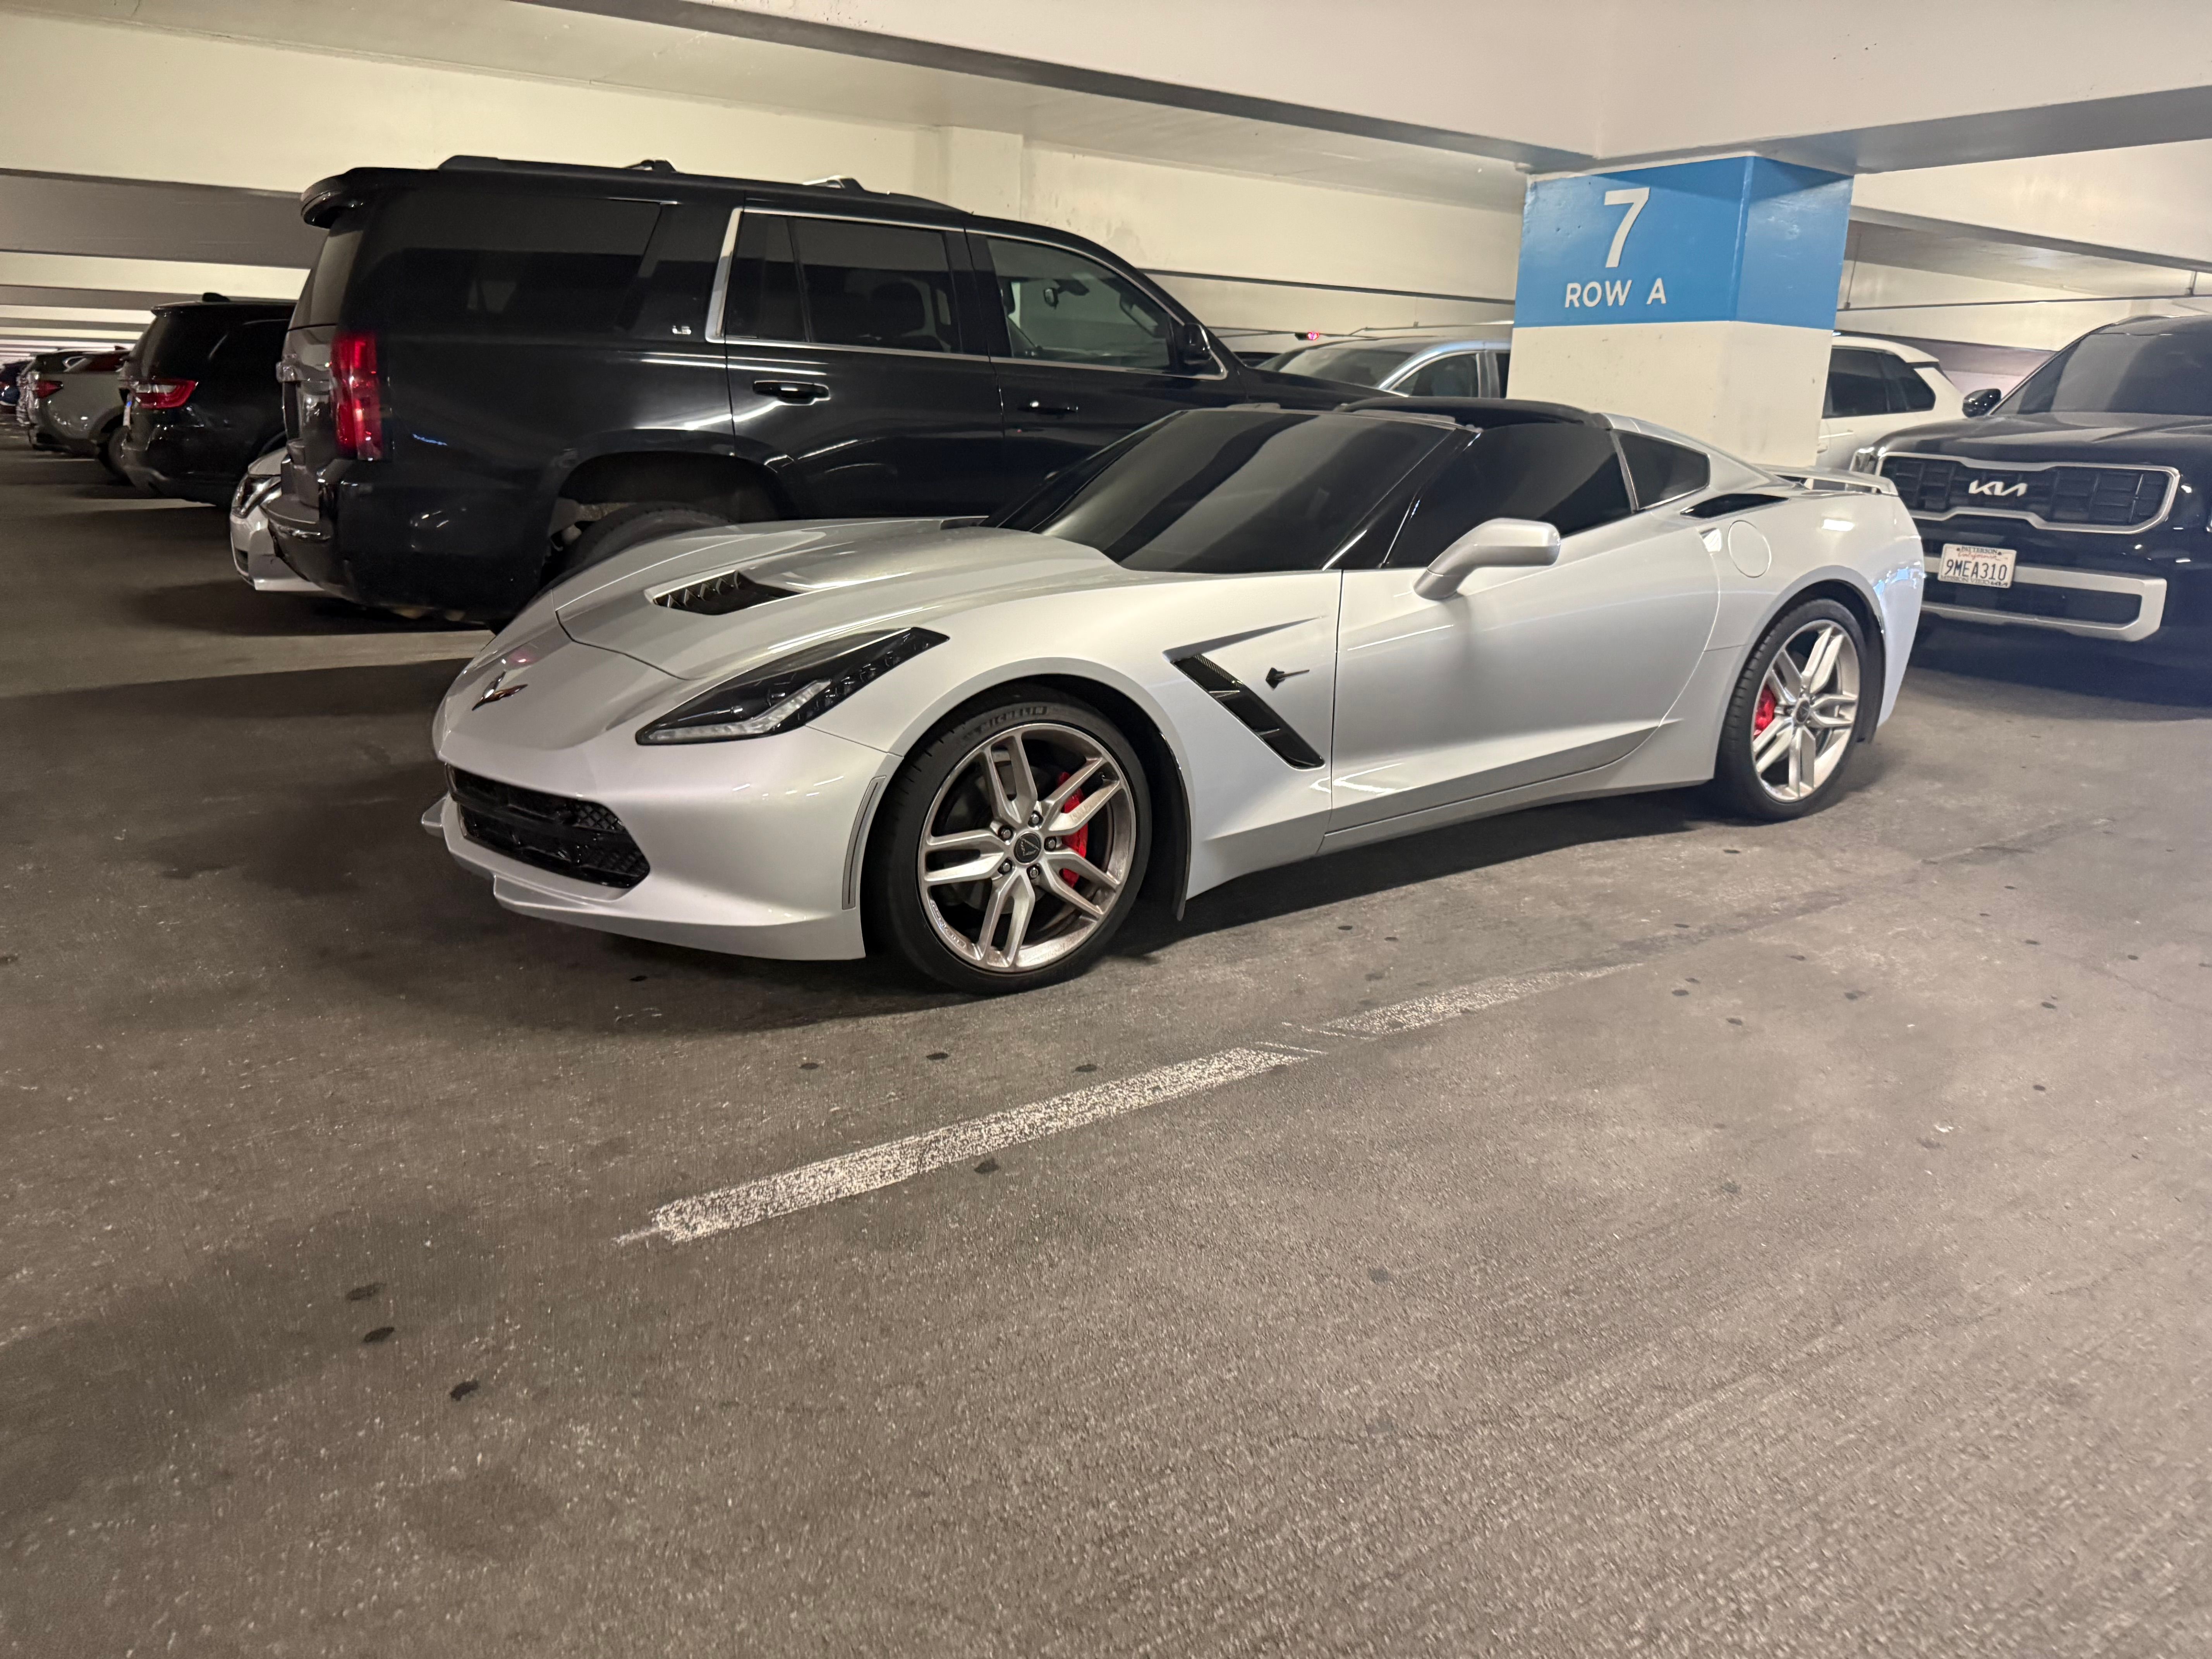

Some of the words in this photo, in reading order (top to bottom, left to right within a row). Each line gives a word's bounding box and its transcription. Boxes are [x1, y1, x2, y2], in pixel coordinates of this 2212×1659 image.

[1604, 186, 1650, 268] 7
[1565, 280, 1633, 308] ROW
[1646, 277, 1667, 305] A
[1958, 551, 2002, 561] California
[1961, 546, 1997, 555] PATTERSON
[1944, 559, 2008, 581] 9MEA310
[980, 706, 1047, 731] MICHELIN
